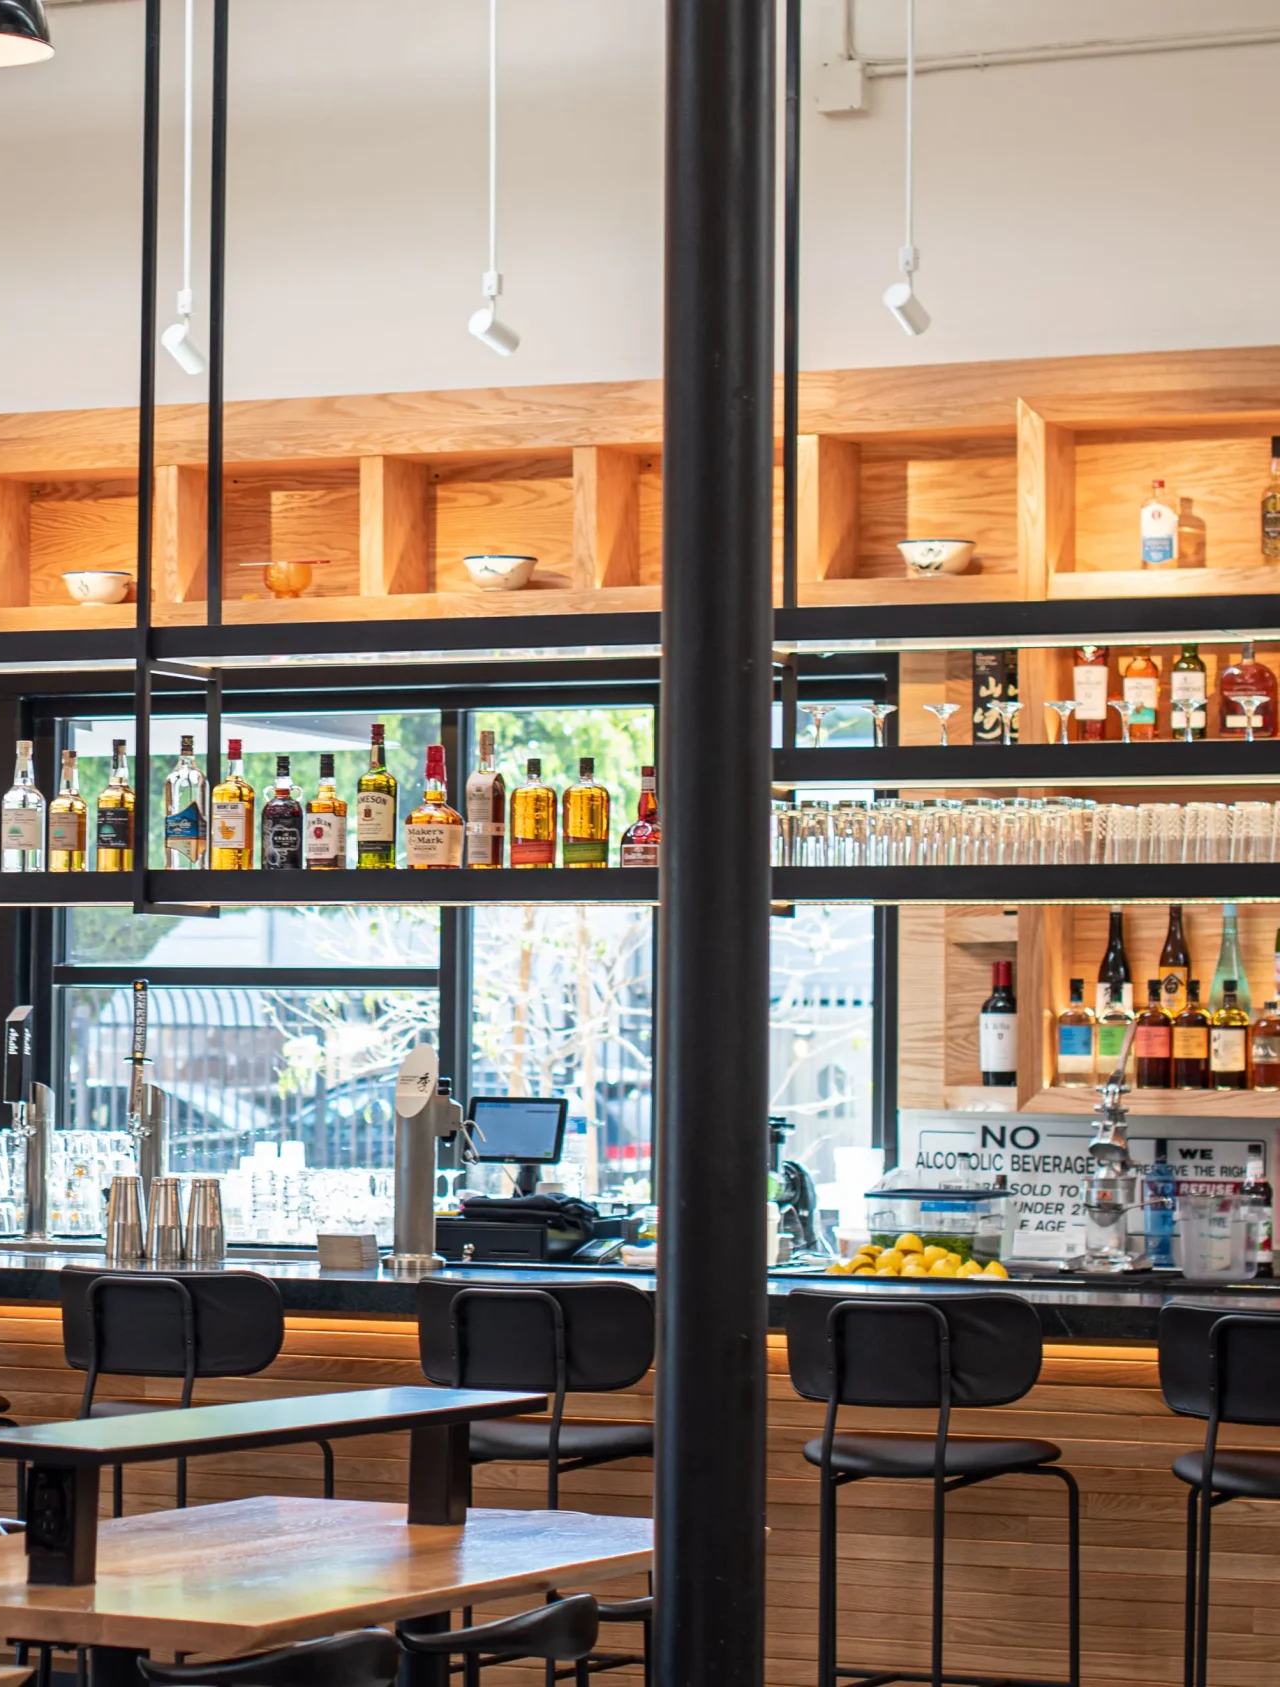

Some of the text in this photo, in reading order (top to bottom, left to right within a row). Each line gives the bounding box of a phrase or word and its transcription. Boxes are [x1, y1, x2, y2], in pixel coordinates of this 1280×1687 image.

[408, 828, 444, 836] Maker's
[417, 836, 444, 844] Mark
[981, 1125, 1040, 1150] NO
[1178, 1148, 1214, 1160] WE
[916, 1151, 1003, 1171] ALCOOLIC
[1193, 1165, 1217, 1177] THE
[1220, 1165, 1248, 1178] RIGH
[1010, 1183, 1052, 1197] SOLD
[1059, 1185, 1080, 1198] TO
[1180, 1186, 1234, 1195] REFUSE
